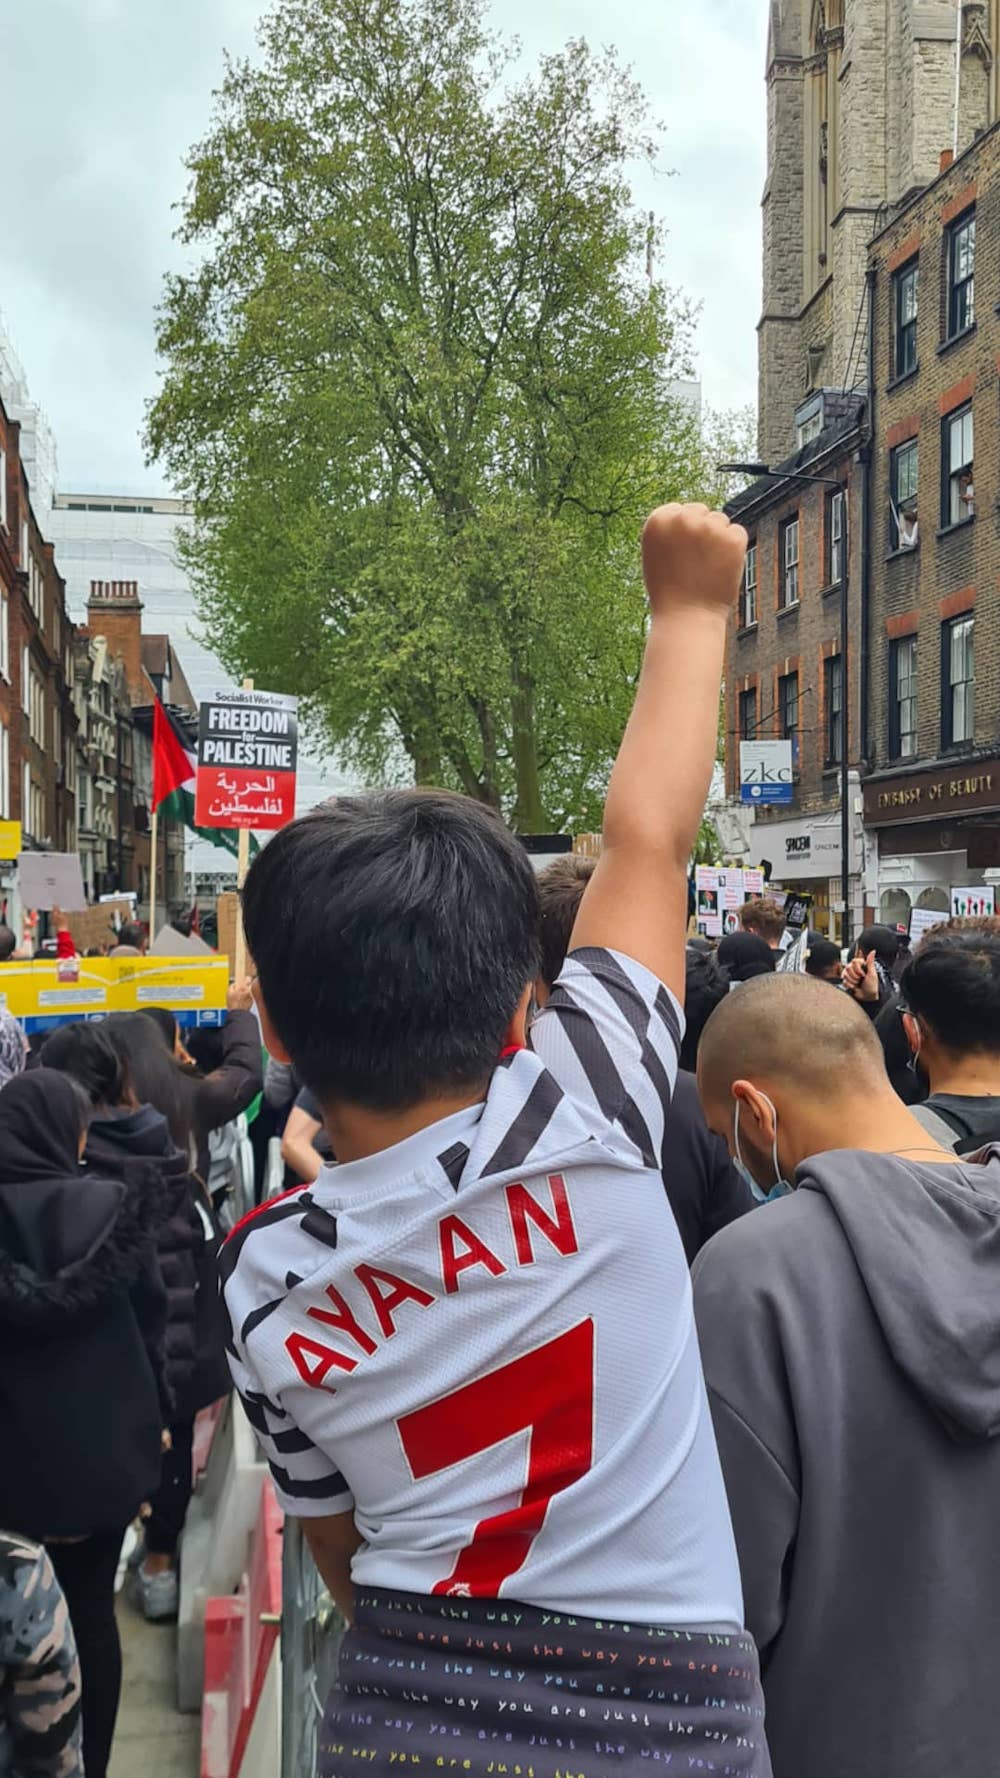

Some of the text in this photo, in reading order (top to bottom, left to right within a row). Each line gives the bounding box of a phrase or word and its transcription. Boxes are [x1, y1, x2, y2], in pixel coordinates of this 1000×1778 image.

[215, 692, 252, 703] Socialist
[208, 707, 289, 734] FREEDOM
[241, 731, 256, 742] for
[203, 740, 292, 767] PALESTINE
[216, 772, 275, 796] الحرية
[743, 761, 790, 782] zkc
[928, 783, 943, 800] OF
[949, 775, 992, 797] BEAUTY
[208, 794, 283, 816] لفلسطين
[394, 1314, 597, 1598] 7
[440, 1607, 469, 1619] the
[486, 1611, 523, 1626] way
[542, 1614, 577, 1626] you
[595, 1621, 631, 1633] are
[707, 1634, 730, 1646] the
[416, 1632, 450, 1644] are
[466, 1637, 513, 1653] just
[533, 1644, 564, 1656] the
[581, 1649, 619, 1664] way
[638, 1654, 672, 1667] you
[688, 1661, 719, 1673] are
[388, 1660, 428, 1671] just
[444, 1663, 474, 1675] the
[489, 1668, 526, 1682] way
[544, 1673, 578, 1689] you
[596, 1683, 631, 1695] are
[647, 1688, 690, 1704] just
[705, 1696, 726, 1708] the
[444, 1697, 479, 1710] way
[498, 1700, 533, 1712] you
[551, 1705, 587, 1717] are
[603, 1709, 650, 1726] just
[668, 1719, 694, 1734] the
[705, 1730, 728, 1744] way
[351, 1712, 372, 1725] the
[384, 1719, 414, 1732] way
[429, 1723, 462, 1736] you
[478, 1729, 513, 1741] are
[528, 1735, 575, 1749] just
[595, 1741, 625, 1753] the
[641, 1749, 673, 1764] way
[688, 1756, 716, 1770] you
[352, 1747, 377, 1760] way
[389, 1752, 421, 1764] you
[436, 1755, 471, 1769] are
[487, 1761, 535, 1778] just
